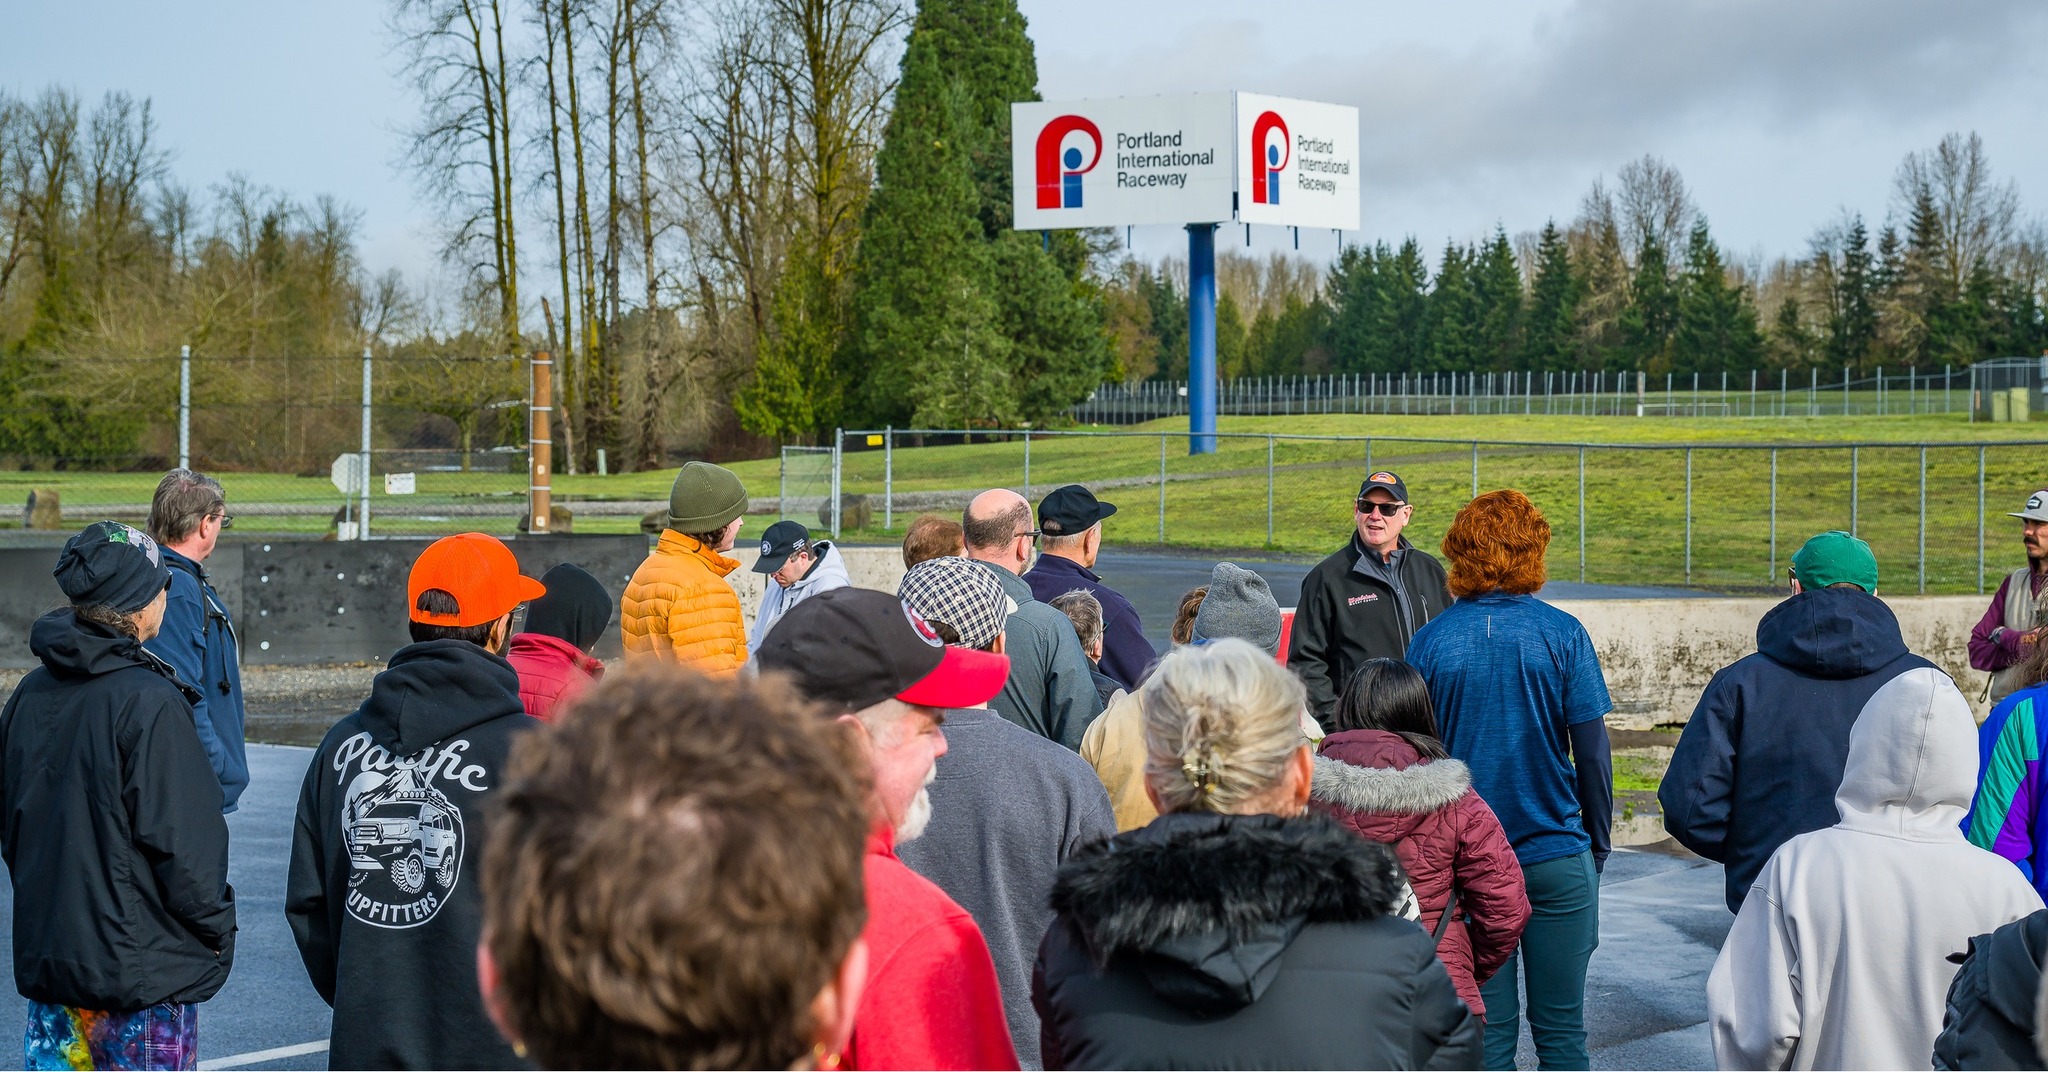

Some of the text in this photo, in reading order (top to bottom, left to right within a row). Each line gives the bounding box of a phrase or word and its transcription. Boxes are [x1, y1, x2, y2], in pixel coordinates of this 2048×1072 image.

[1117, 130, 1182, 149] Portland
[1297, 134, 1333, 154] Portland
[1117, 148, 1214, 168] International
[1298, 154, 1349, 175] International
[1117, 171, 1187, 188] Raceway
[1298, 173, 1336, 195] Raceway
[347, 888, 438, 923] UPFITTERS
